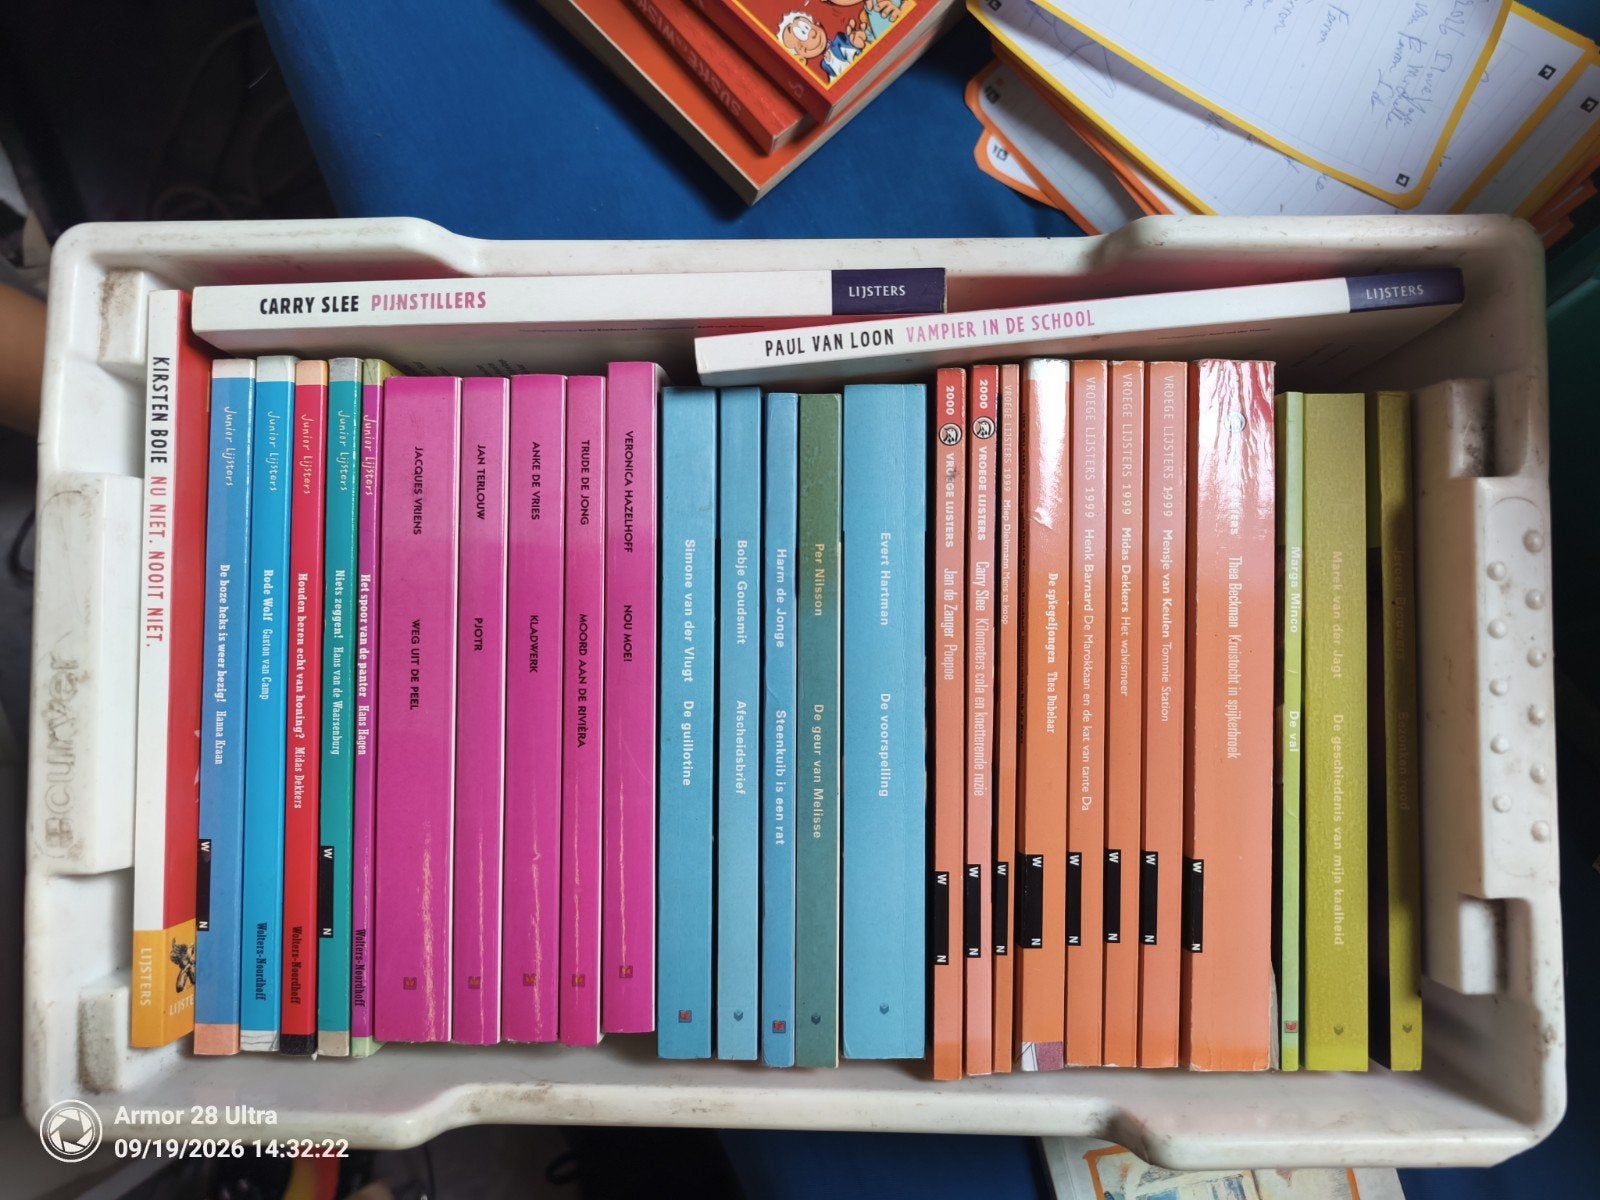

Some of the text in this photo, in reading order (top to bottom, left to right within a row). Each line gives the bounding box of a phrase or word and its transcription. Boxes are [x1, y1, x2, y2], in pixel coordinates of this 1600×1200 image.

[260, 291, 486, 315] CARRY SLEE PIJNSTILLERS
[849, 285, 906, 299] LIJSTERS
[1366, 285, 1424, 300] LIJSTERS
[765, 310, 1094, 357] PAUL VAN LOON VAMPIER IN DE SCHOOL
[222, 406, 237, 486] Junior Lijsters
[531, 442, 541, 520] ANKE DE VRIES
[580, 440, 590, 525] TRUDE DE JONG
[146, 357, 170, 647] KIRSTEN BOIE NU NIET. NOOIT NIET.
[413, 446, 423, 535] JACQUES VRIENS
[624, 430, 634, 553] VERONICA HAZELHOFF
[978, 446, 987, 540] VROEGE LIJSTERS
[814, 544, 825, 616] Per Nilsson
[880, 532, 891, 626] Evert Hartman
[1160, 375, 1174, 722] VROEGE LIJSTERS 1999 Mensje van Keulen Tommie Station
[298, 573, 308, 613] Houden
[681, 539, 695, 682] Simone van der Vlugt
[735, 540, 748, 644] Bobje Goudsmit
[774, 549, 787, 648] Harm de Jonge
[1289, 547, 1301, 633] Marga Minco
[214, 564, 230, 764] De boze heks is weer bezig! Hanna Kraan
[259, 570, 274, 700] Rode Wolf Gaston van Camp
[296, 648, 306, 670] echt
[297, 616, 307, 645] beren
[330, 570, 345, 755] Niets zeggen! Hans van de Waarsenburg
[410, 619, 420, 710] WEG UIT DE PEEL
[530, 615, 538, 672] KLADWERK
[623, 605, 632, 662] NOU MOE!
[1045, 573, 1058, 733] De spiegeljongen Thea Dubelaar
[1081, 529, 1094, 811] Henk Barnard De Marokkaan en de kat van tante Da
[1225, 556, 1242, 758] Thea Beckman Kruistocht in spijkerbroek
[293, 695, 305, 738] honing?
[577, 614, 588, 748] MOORD AAN DE RIVIÈRA
[814, 704, 824, 721] De
[972, 562, 990, 796] Carry Slee Kilometers cola en knetterende ruzie
[295, 747, 305, 772] Midas
[681, 701, 694, 786] De guillotine
[735, 700, 747, 794] Afscheidsbrief
[776, 710, 787, 776] Steenkuib
[812, 726, 821, 755] geur
[878, 694, 891, 796] De voorspelling
[1289, 711, 1300, 752] De val
[294, 775, 304, 808] Dekkers
[776, 782, 786, 792] is
[813, 788, 824, 838] Melisse
[776, 826, 785, 845] rat
[1331, 736, 1345, 945] geschiedenis kaalheid
[938, 874, 946, 885] W
[139, 948, 152, 1006] LIJSTERS
[255, 922, 267, 1001] Wolters-Noordhoff
